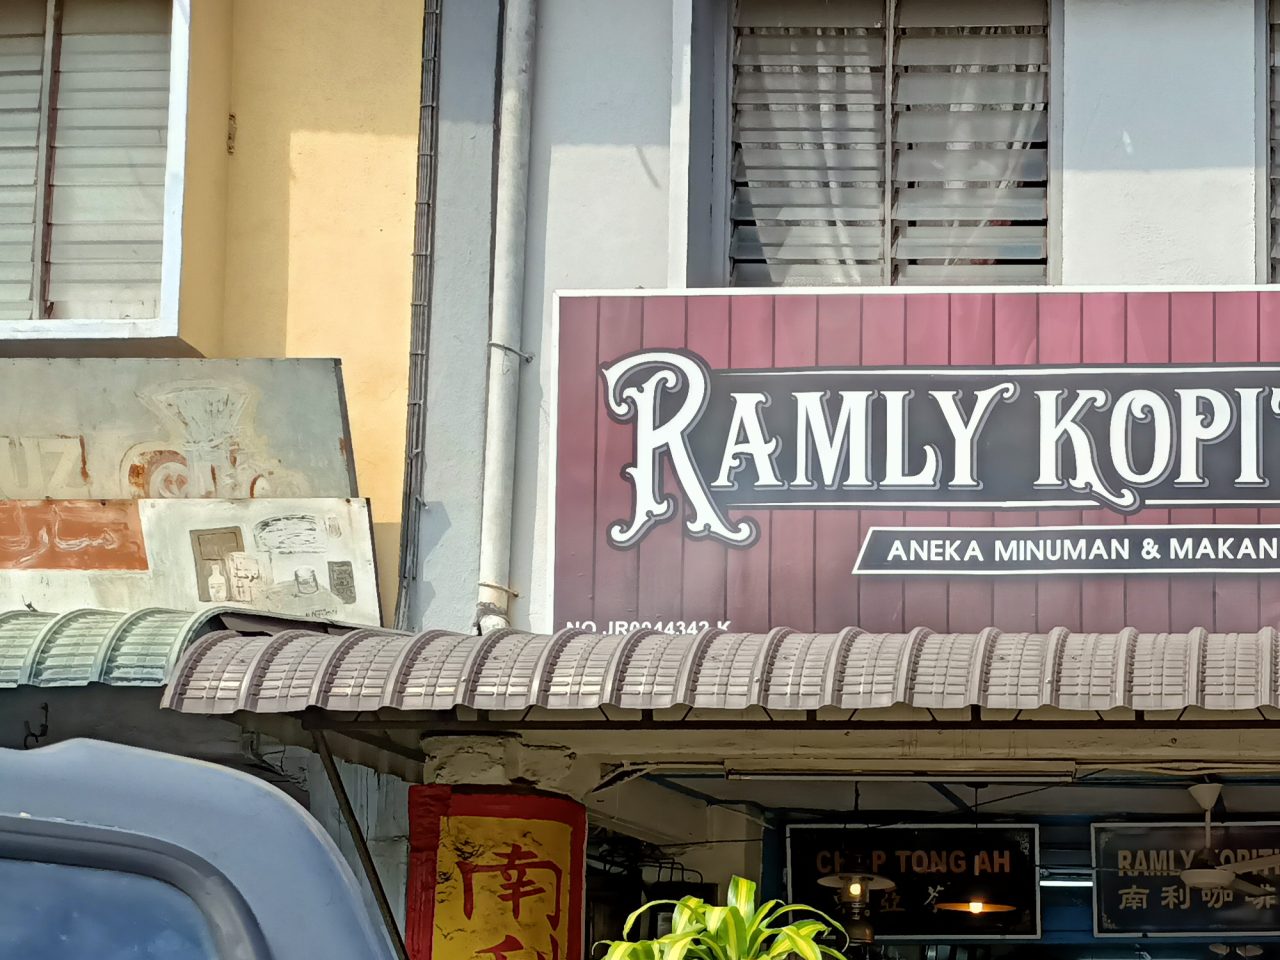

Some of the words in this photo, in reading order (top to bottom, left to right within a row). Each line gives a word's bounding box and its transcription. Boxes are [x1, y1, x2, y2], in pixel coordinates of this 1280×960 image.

[602, 352, 1018, 548] RAMLY
[886, 539, 984, 562] ANEKA
[994, 538, 1130, 562] MINUMAN
[1141, 538, 1162, 561] &
[816, 850, 887, 873] CHP
[895, 850, 967, 874] TONG
[977, 850, 1011, 873] AH
[1118, 850, 1196, 877] RAMLY
